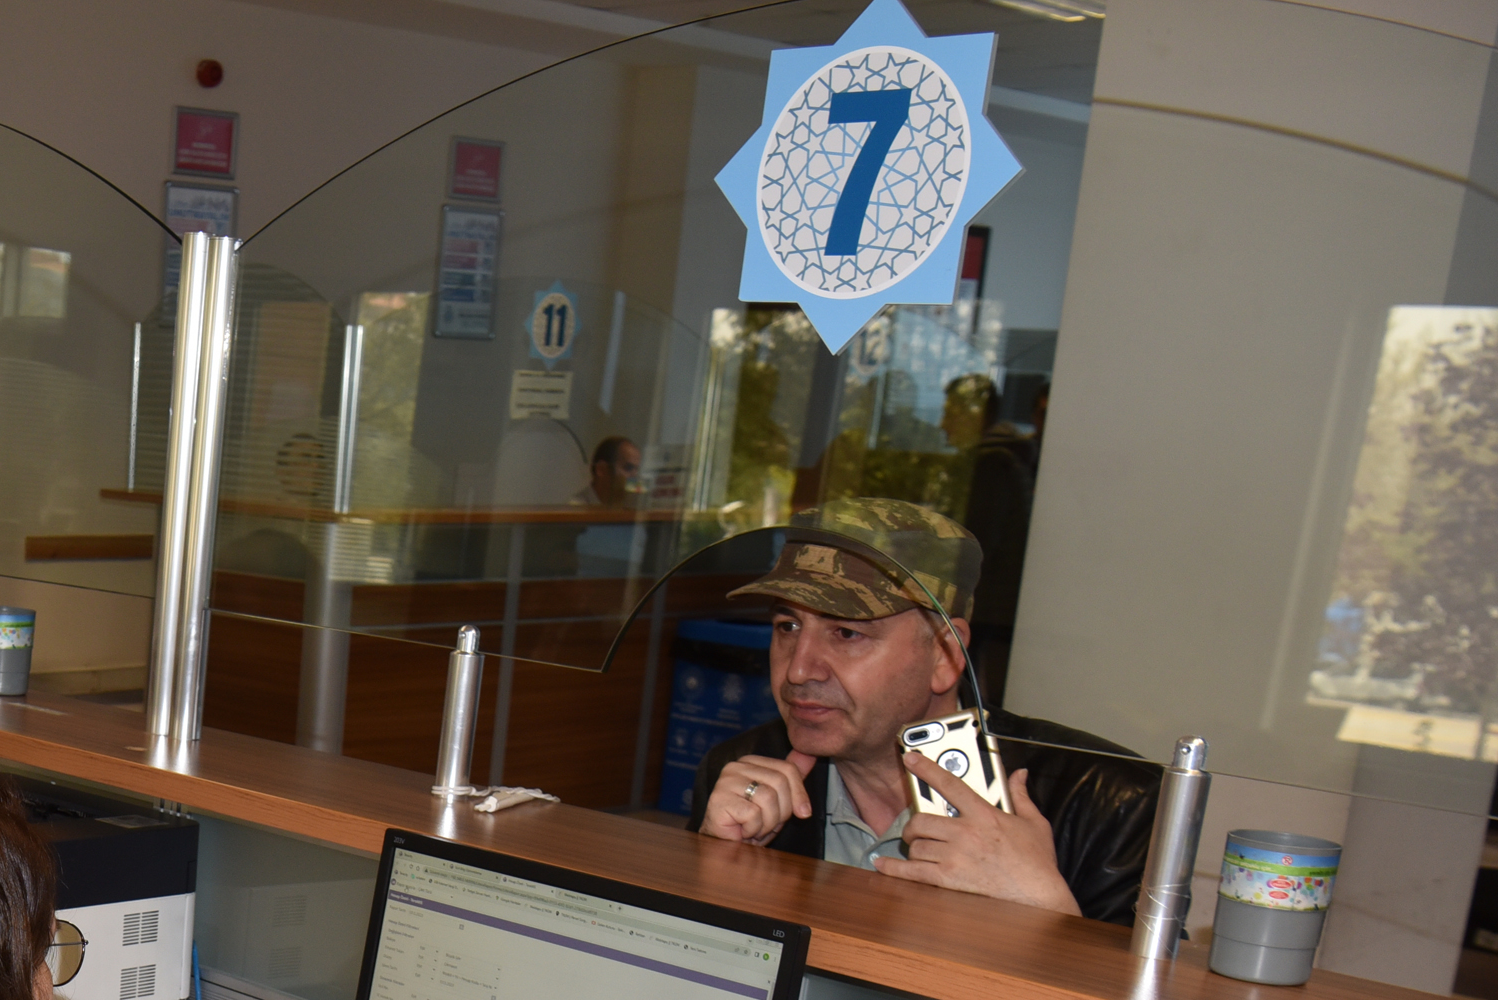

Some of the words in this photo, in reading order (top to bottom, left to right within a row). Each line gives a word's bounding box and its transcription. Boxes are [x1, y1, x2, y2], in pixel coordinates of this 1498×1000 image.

[824, 88, 913, 256] 7
[543, 303, 568, 347] 11
[772, 928, 786, 938] LED
